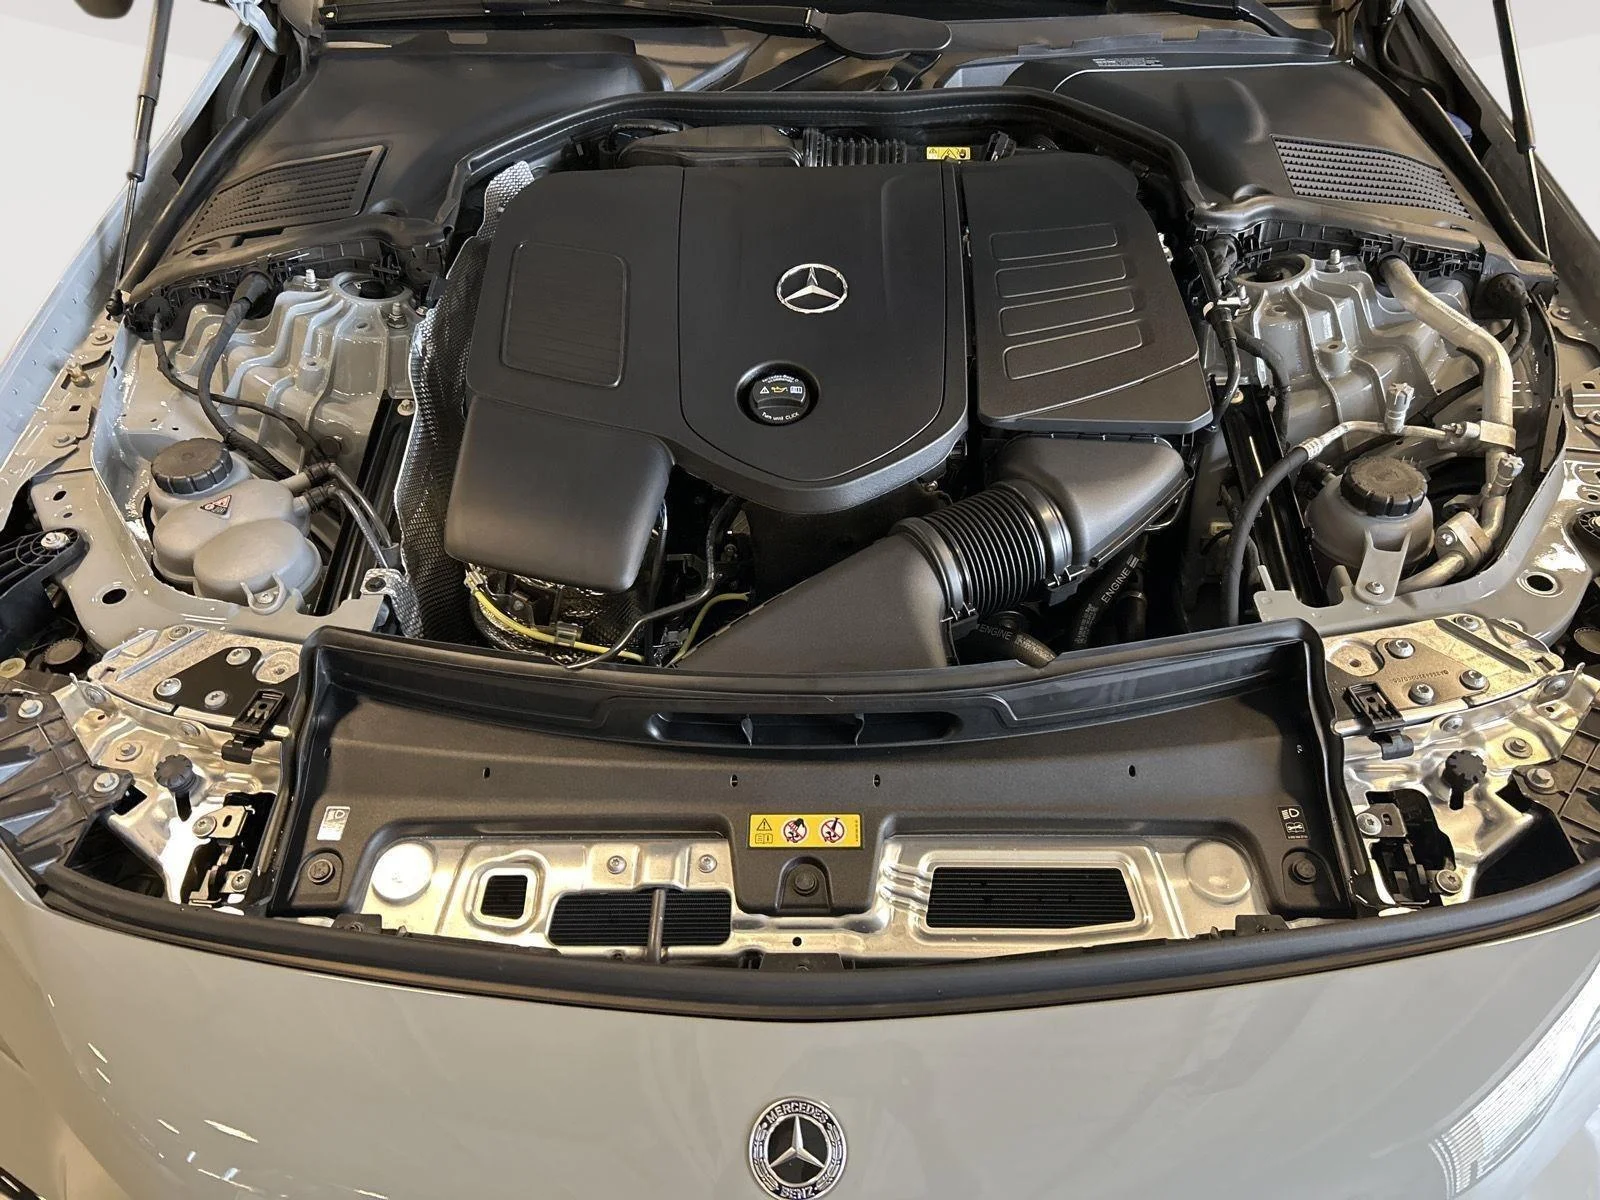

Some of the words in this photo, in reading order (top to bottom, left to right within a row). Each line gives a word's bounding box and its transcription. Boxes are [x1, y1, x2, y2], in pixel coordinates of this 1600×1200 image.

[1100, 567, 1131, 604] ENGINE
[978, 623, 1013, 641] ENGINE
[765, 1102, 829, 1123] MERCEDES
[780, 1186, 815, 1199] BENZ
